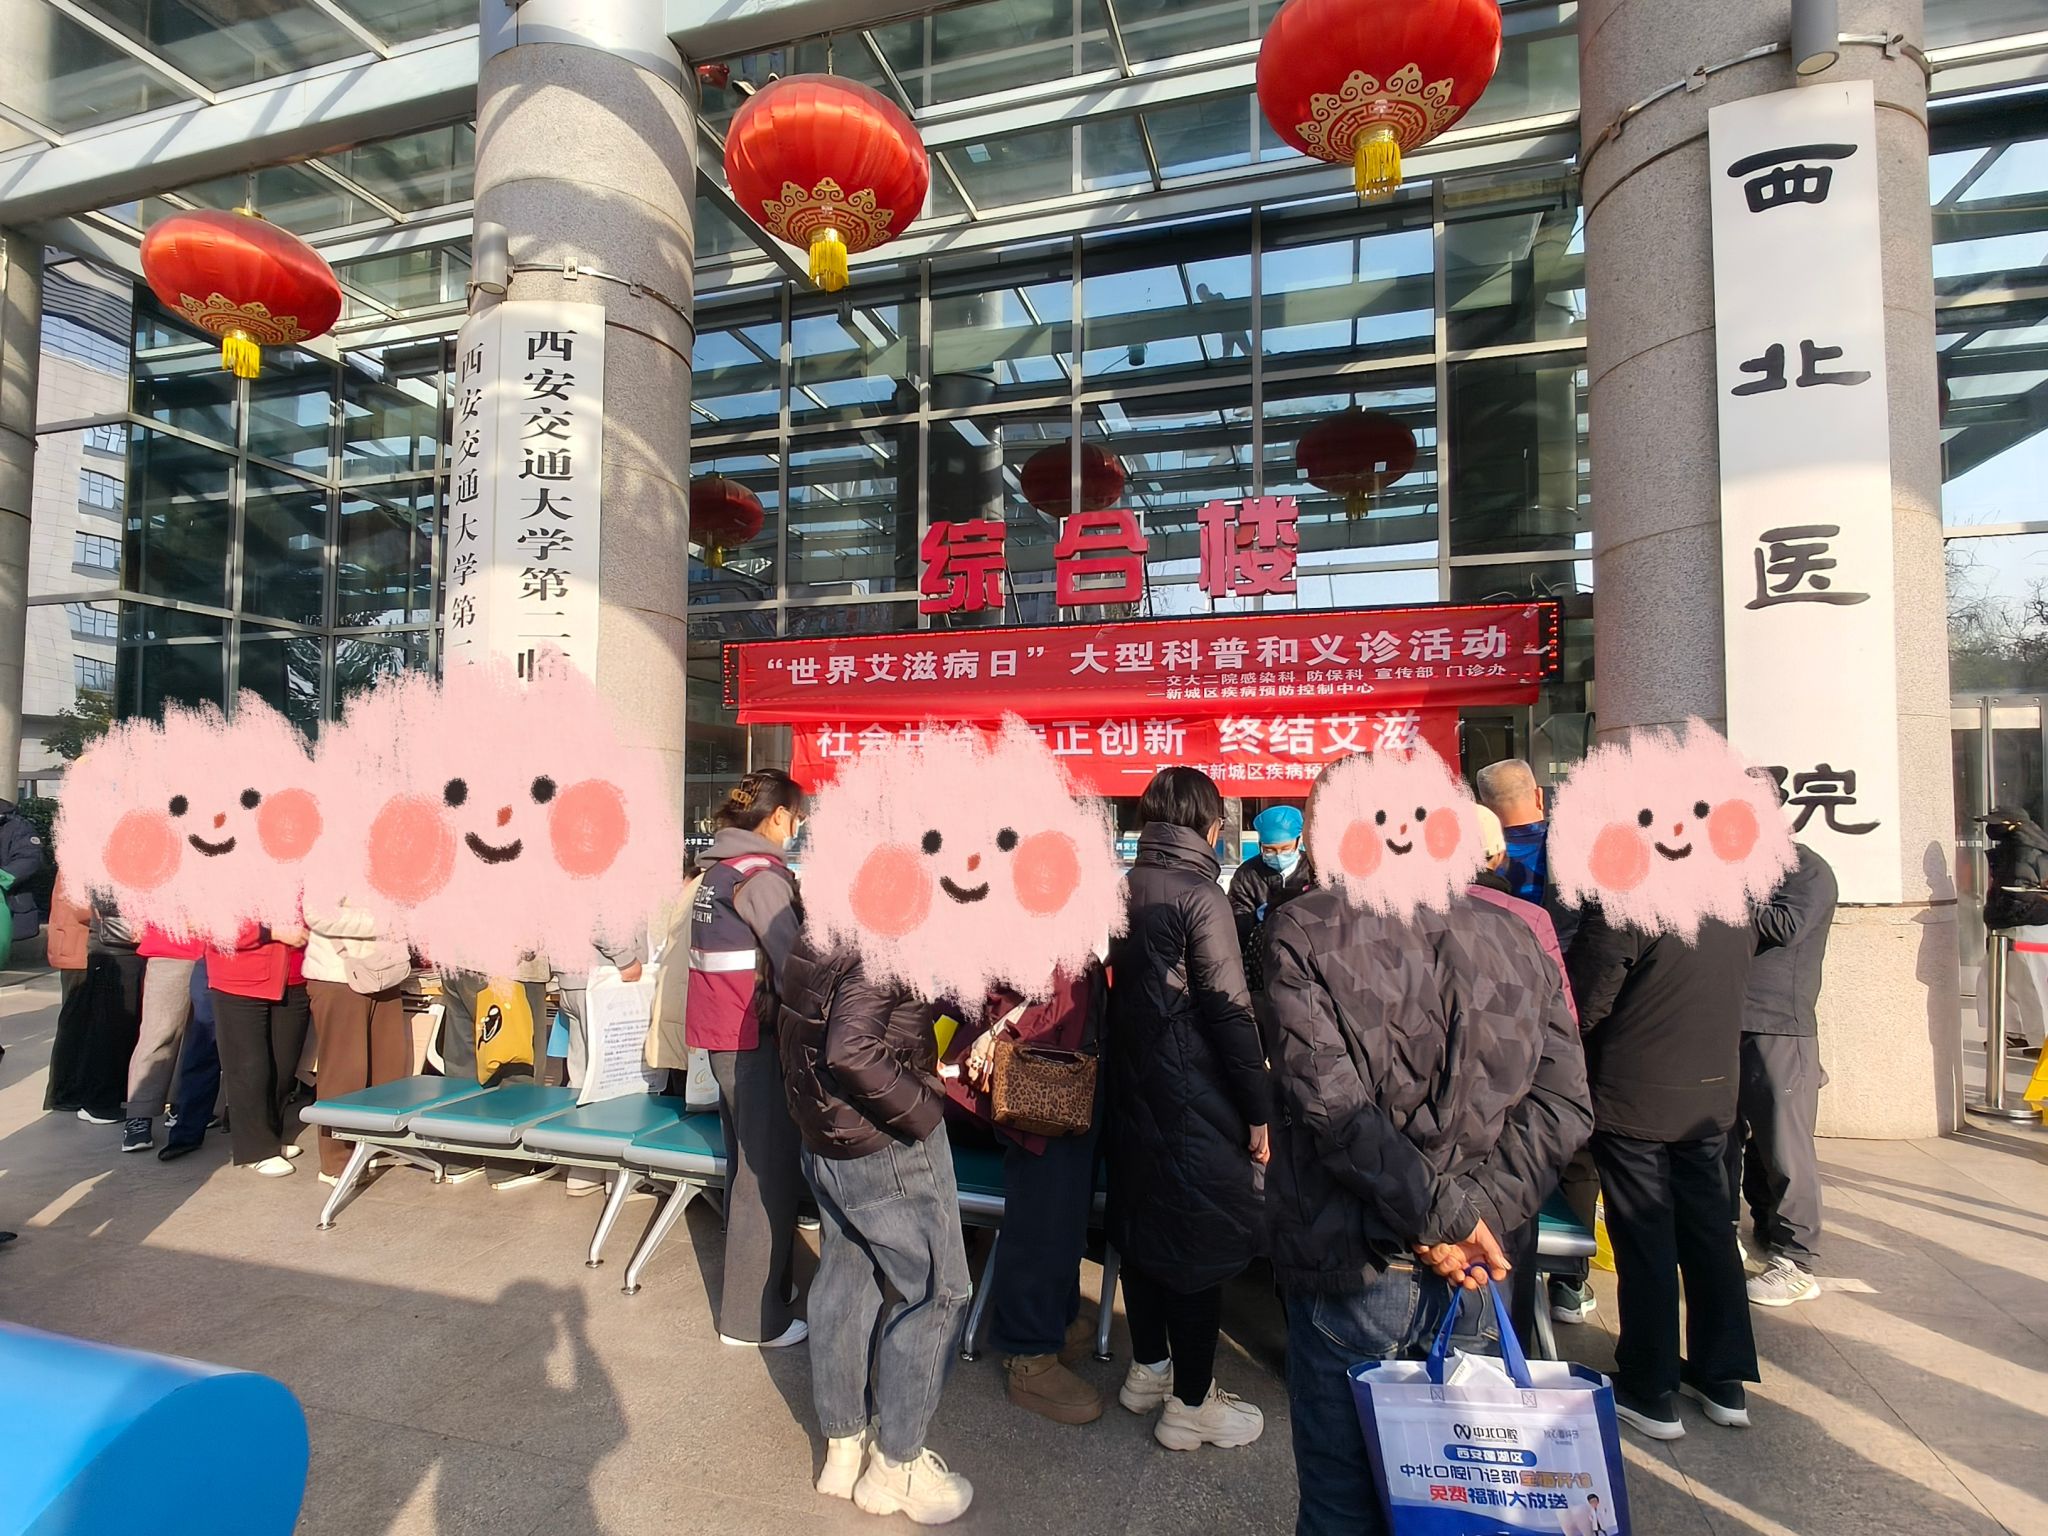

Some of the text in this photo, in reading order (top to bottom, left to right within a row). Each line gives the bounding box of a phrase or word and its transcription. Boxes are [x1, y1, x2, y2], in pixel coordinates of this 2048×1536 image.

[1727, 143, 1881, 835] 西北医院
[919, 495, 1299, 615] 综合楼
[767, 624, 1508, 686] “世界艾滋病日” 大型科普和义诊活动
[1306, 668, 1364, 682] 防保科
[1375, 665, 1434, 680] 宣传部
[1446, 663, 1507, 677] 门诊办
[1026, 717, 1187, 758] 正创新
[1219, 708, 1421, 756] 终结艾滋
[1473, 1427, 1519, 1440] 中北口腔
[1430, 1485, 1569, 1509] 免费福利大放送
